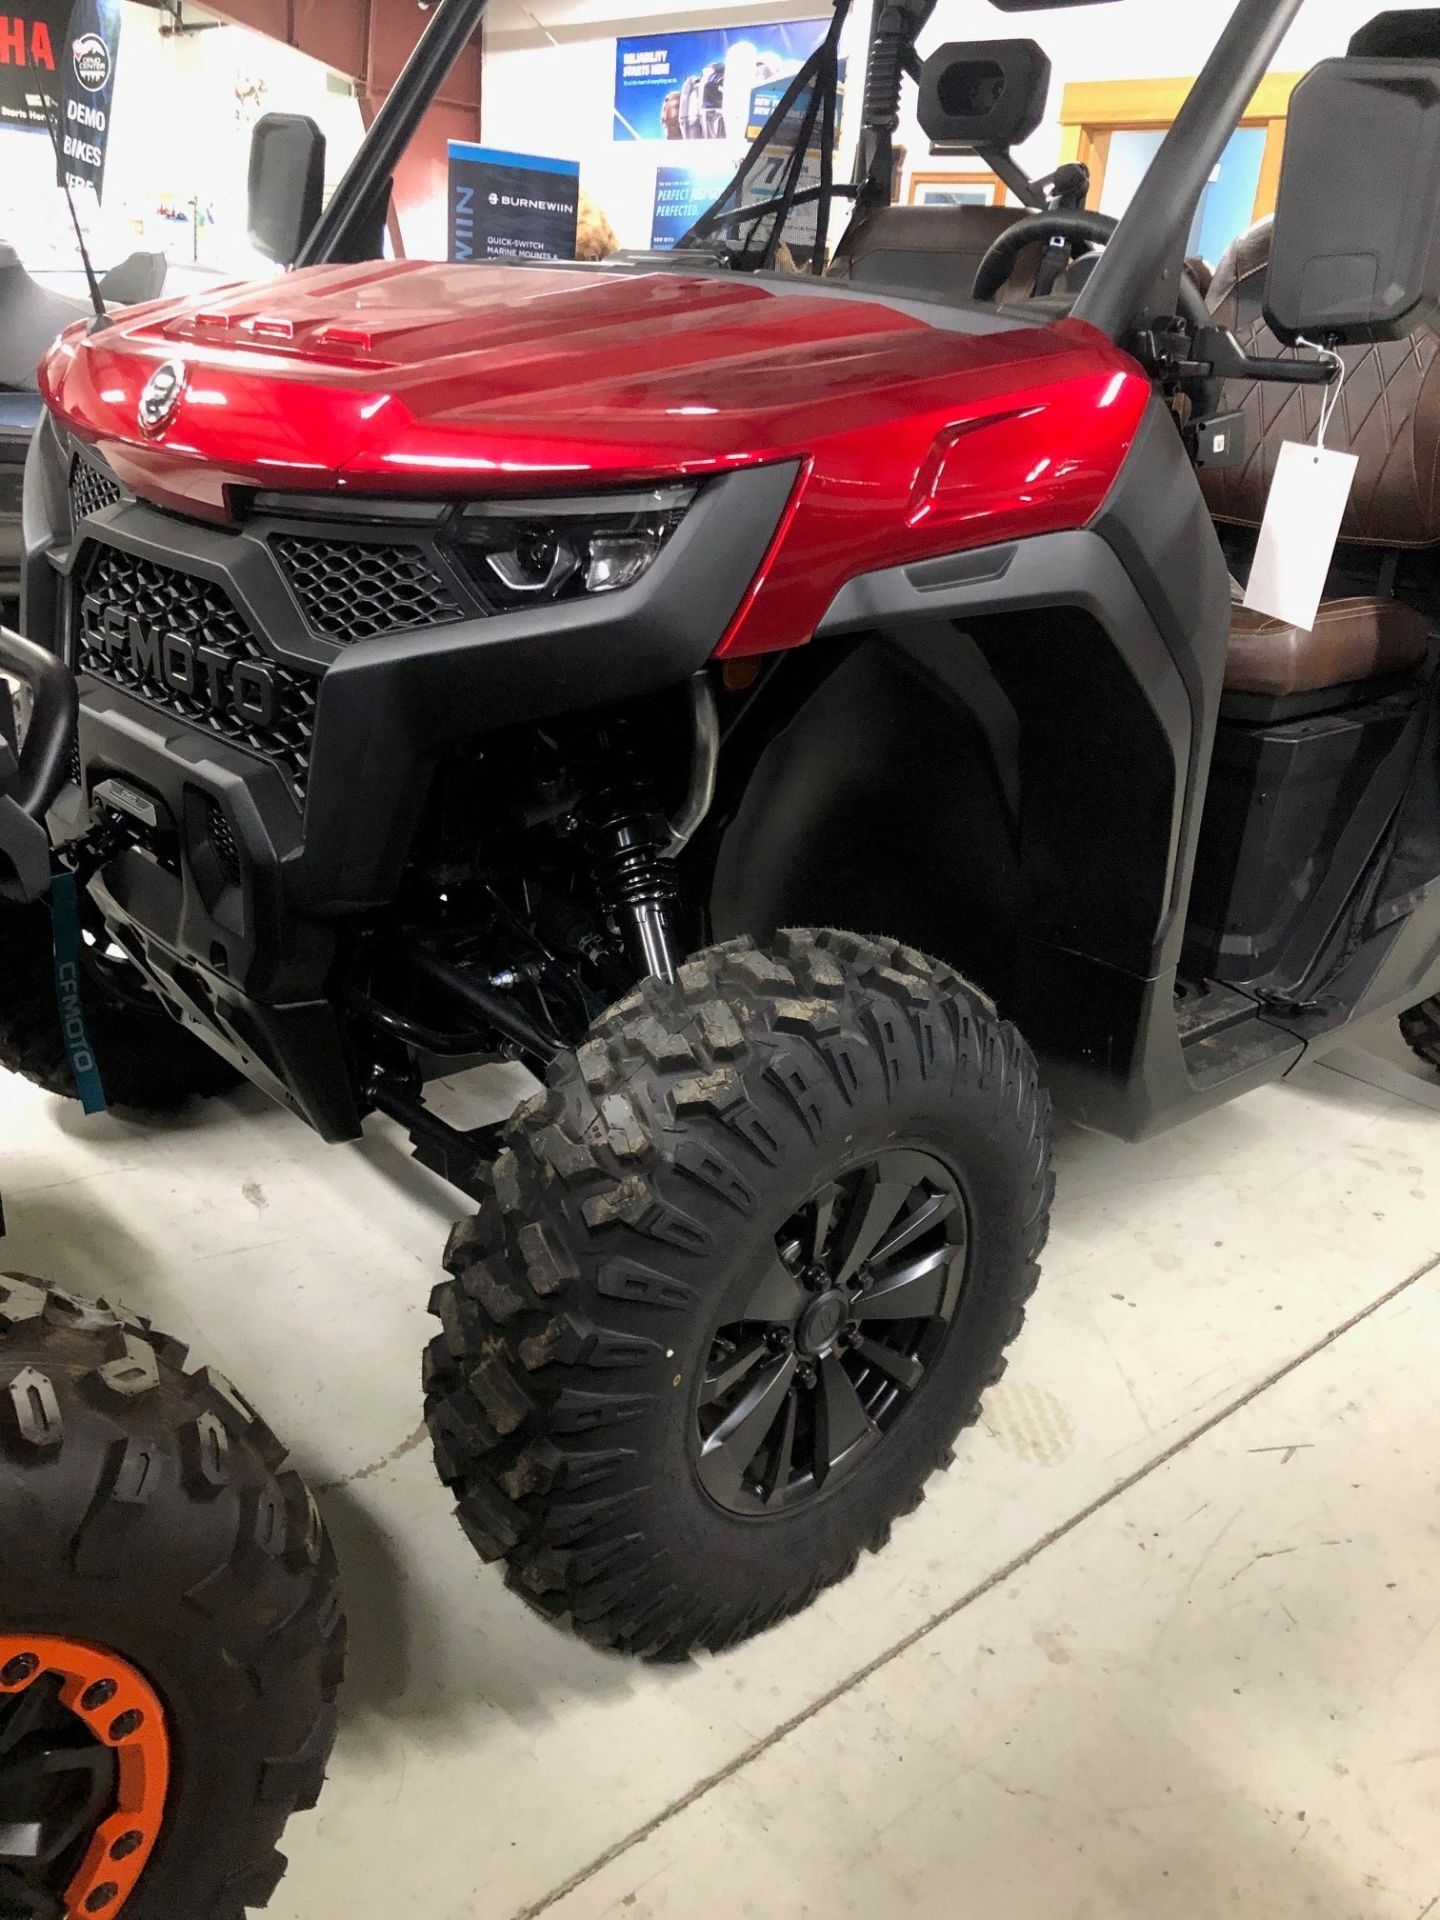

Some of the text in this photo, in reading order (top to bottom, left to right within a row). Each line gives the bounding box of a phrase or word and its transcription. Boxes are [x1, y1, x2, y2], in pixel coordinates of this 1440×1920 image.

[67, 99, 105, 132] DEMO
[64, 135, 102, 167] BIKES
[501, 195, 574, 214] BURNEWIIN
[657, 189, 689, 202] PERFECT
[487, 236, 545, 250] QUICK-SWITCH
[487, 246, 517, 257] MARINE
[82, 593, 278, 725] CFMOTO
[59, 961, 94, 1073] CFMOTO
